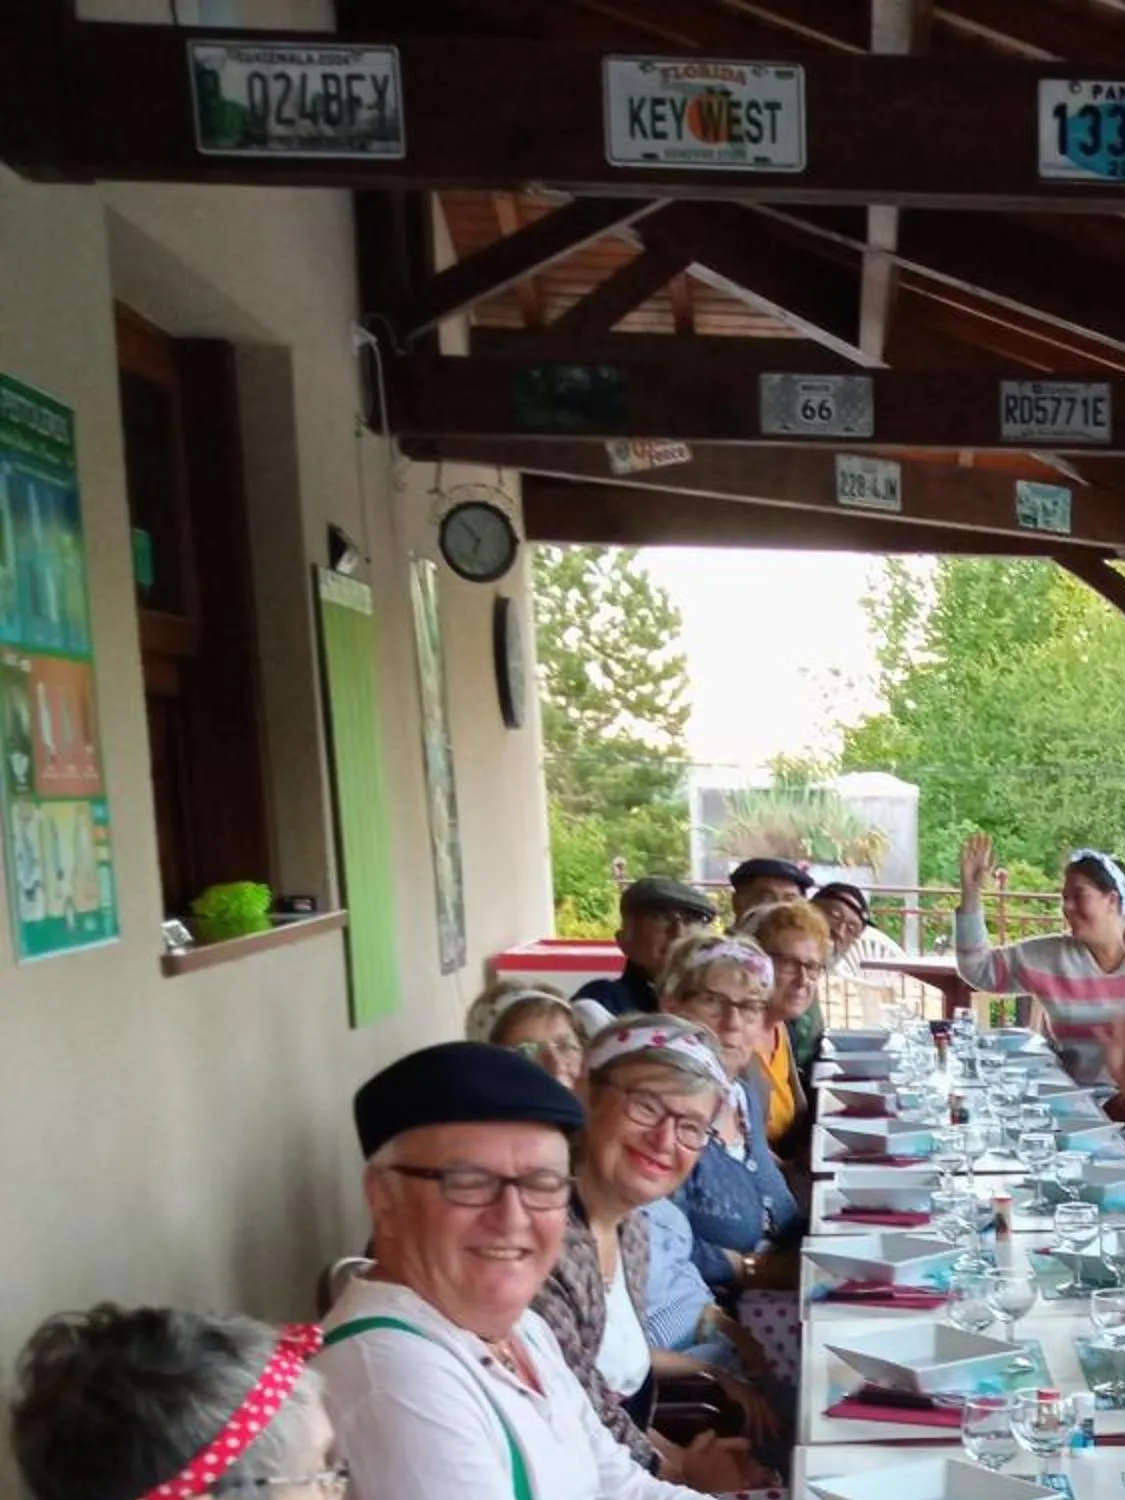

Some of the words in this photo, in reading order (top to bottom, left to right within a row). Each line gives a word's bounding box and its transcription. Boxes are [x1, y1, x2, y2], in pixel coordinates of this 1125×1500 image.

[660, 63, 748, 86] FLORIDA
[627, 95, 688, 141] KEY
[694, 98, 783, 145] WEST
[801, 398, 833, 421] 66
